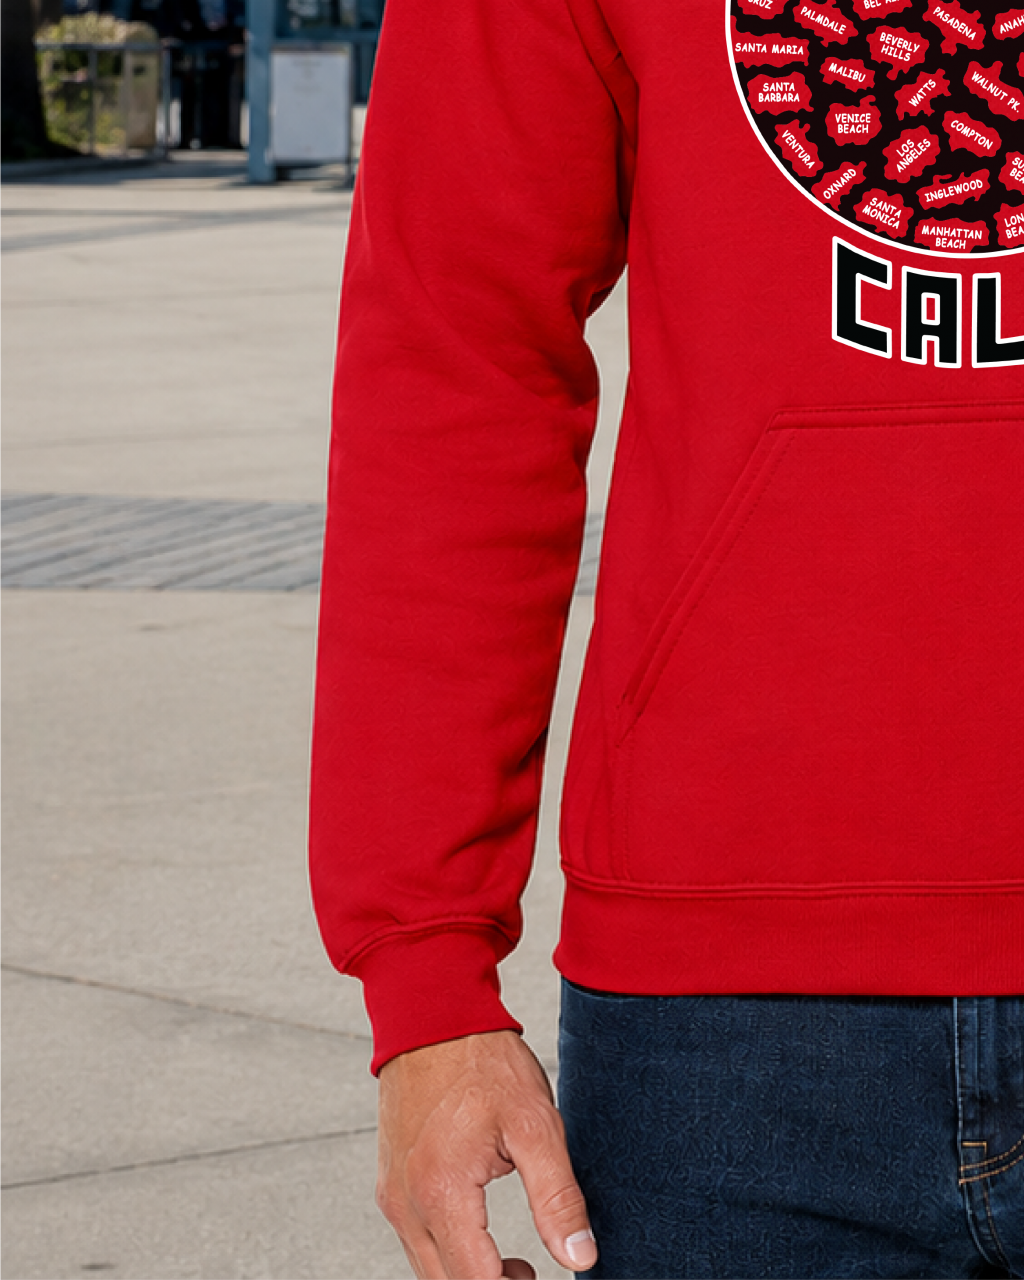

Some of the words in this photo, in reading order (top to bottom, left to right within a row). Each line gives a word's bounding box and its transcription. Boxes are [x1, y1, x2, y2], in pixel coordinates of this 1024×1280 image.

[800, 5, 847, 35] PALMDALE
[932, 6, 977, 41] PASADENA
[734, 42, 768, 54] SANTA
[771, 43, 804, 56] MARIA
[879, 31, 921, 53] BEVERLY
[880, 43, 911, 62] HILLS
[828, 62, 867, 83] MALIBU
[758, 92, 800, 103] BARBARA
[762, 81, 796, 93] SANTA
[908, 78, 937, 107] WATTS
[971, 70, 1009, 101] WALNUT
[1007, 97, 1021, 113] PK.
[834, 112, 872, 124] VENICE
[837, 123, 869, 134] BEACH
[950, 119, 994, 150] COMPTON
[781, 129, 816, 170] VENTURA
[895, 138, 919, 160] LOS
[896, 138, 931, 173] ANGELES
[822, 168, 857, 200] OXNARD
[924, 178, 984, 203] INGLEWOOD
[861, 204, 900, 230] MONICA
[869, 197, 902, 219] SANTA
[921, 224, 983, 240] MANHATTAN
[935, 236, 967, 250] BEACH
